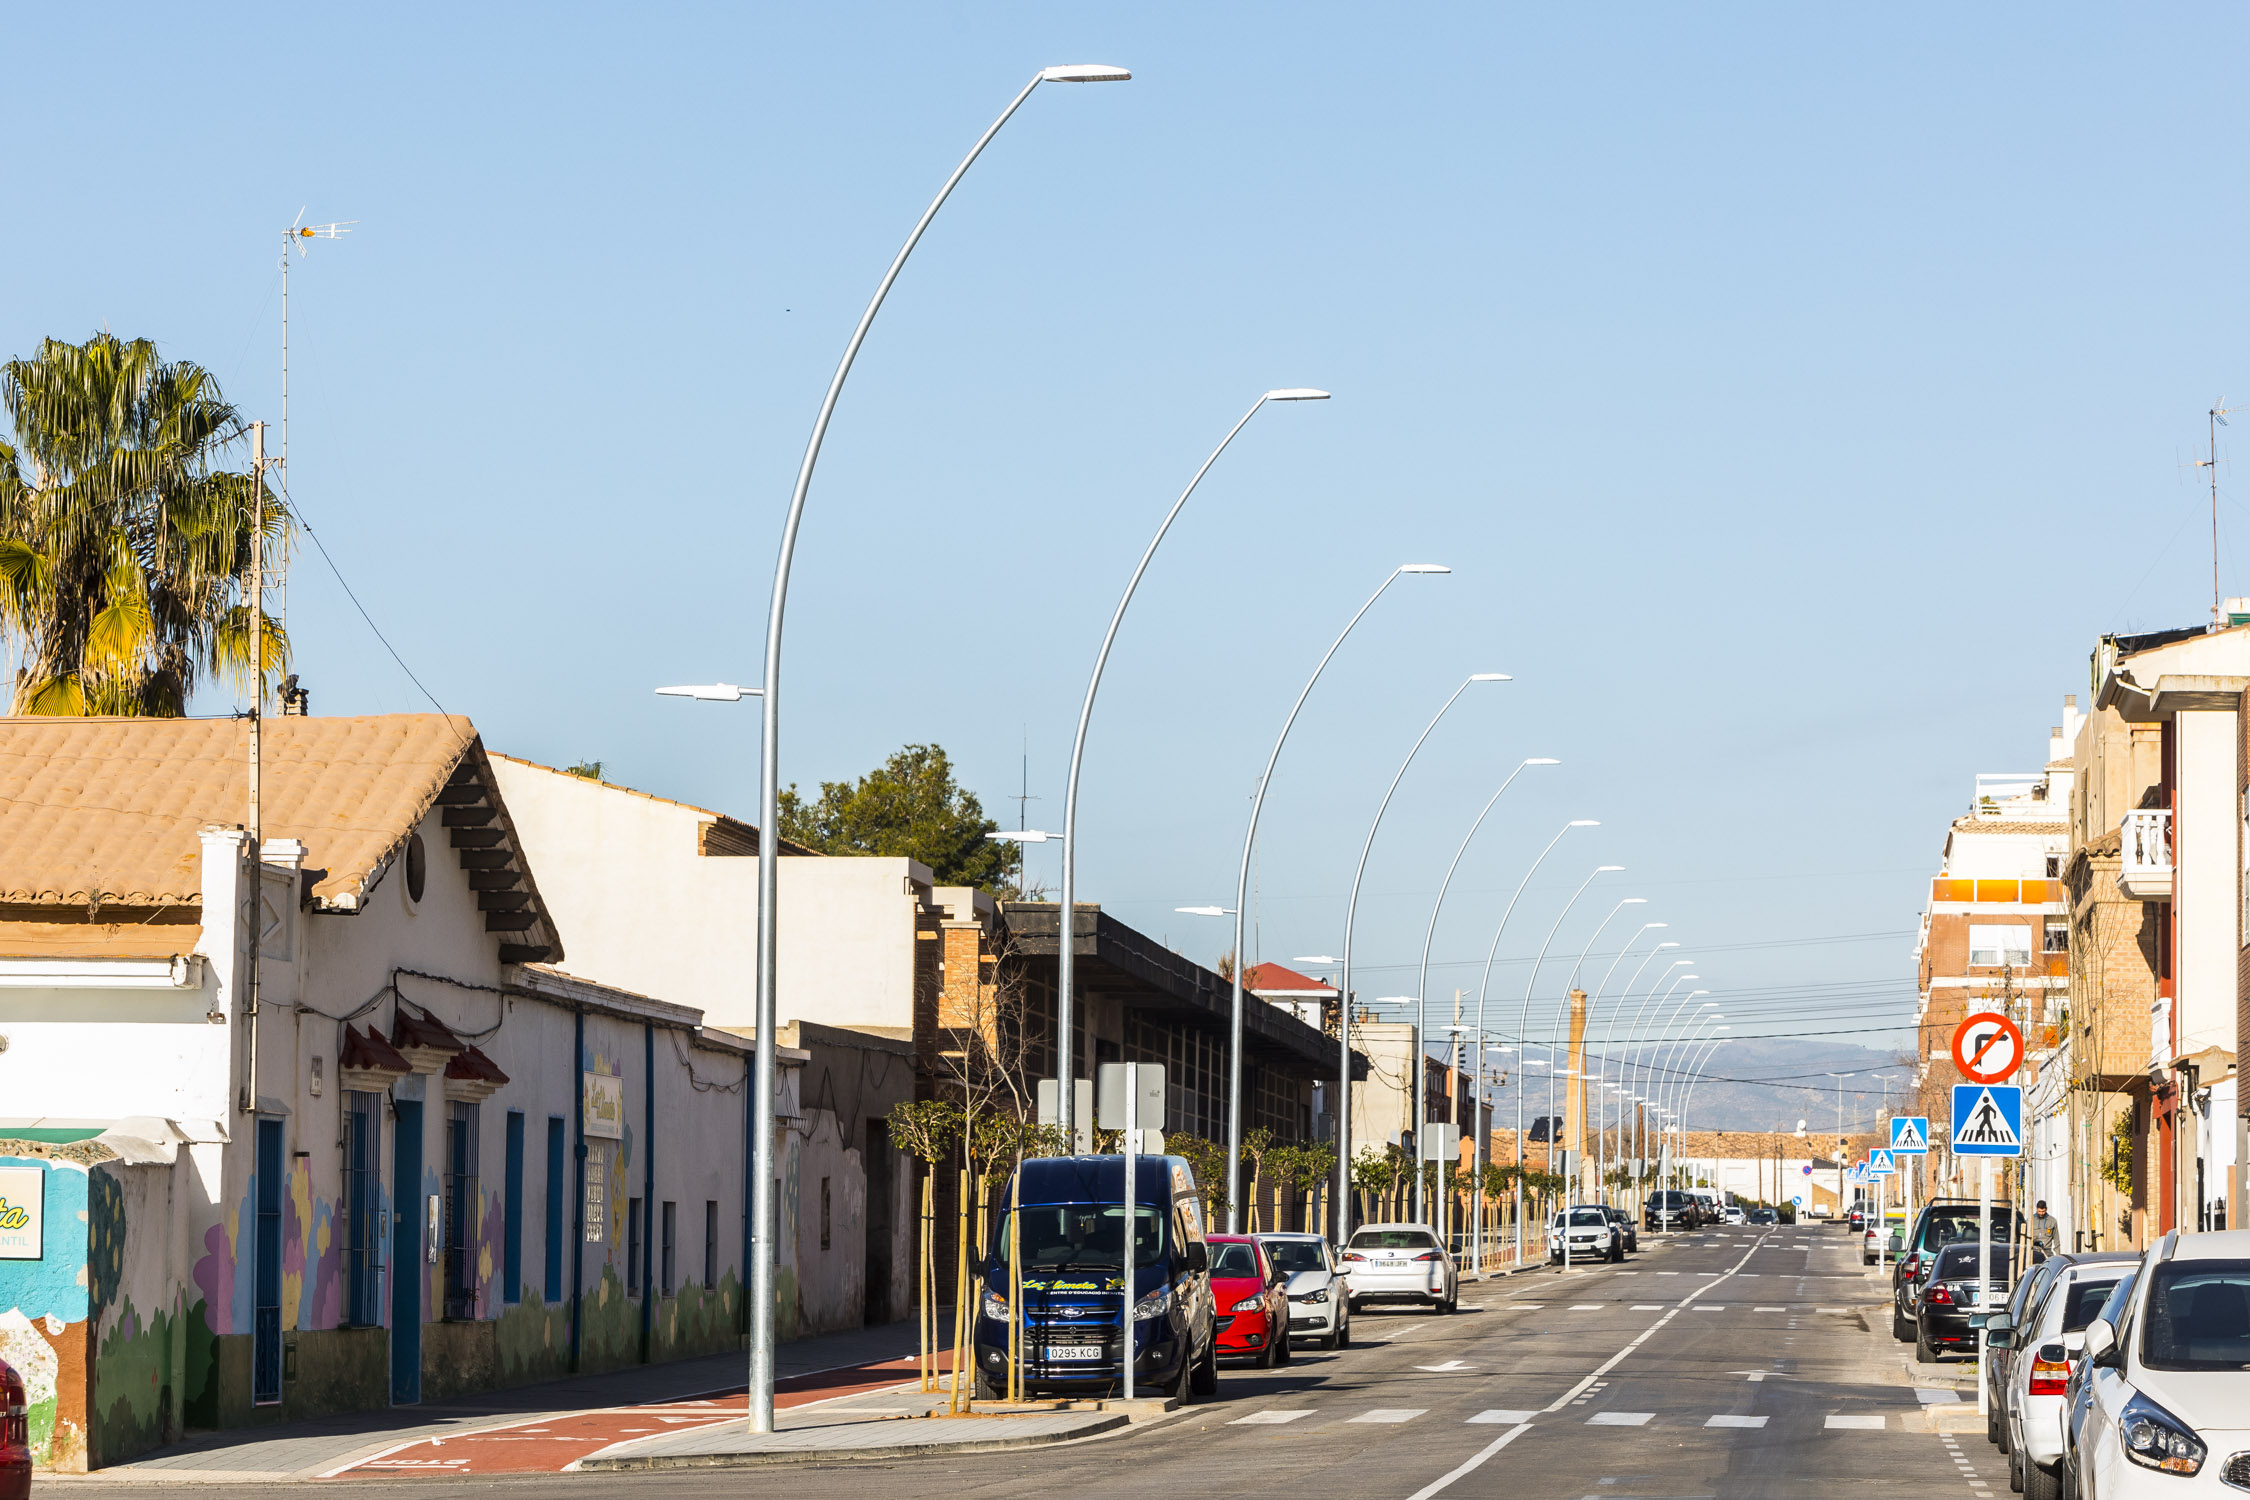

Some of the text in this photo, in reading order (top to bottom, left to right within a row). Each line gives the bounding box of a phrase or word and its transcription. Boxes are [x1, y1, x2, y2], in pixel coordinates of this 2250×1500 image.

[0, 1236, 29, 1246] NTIL
[1051, 1348, 1099, 1358] 0295 KCG
